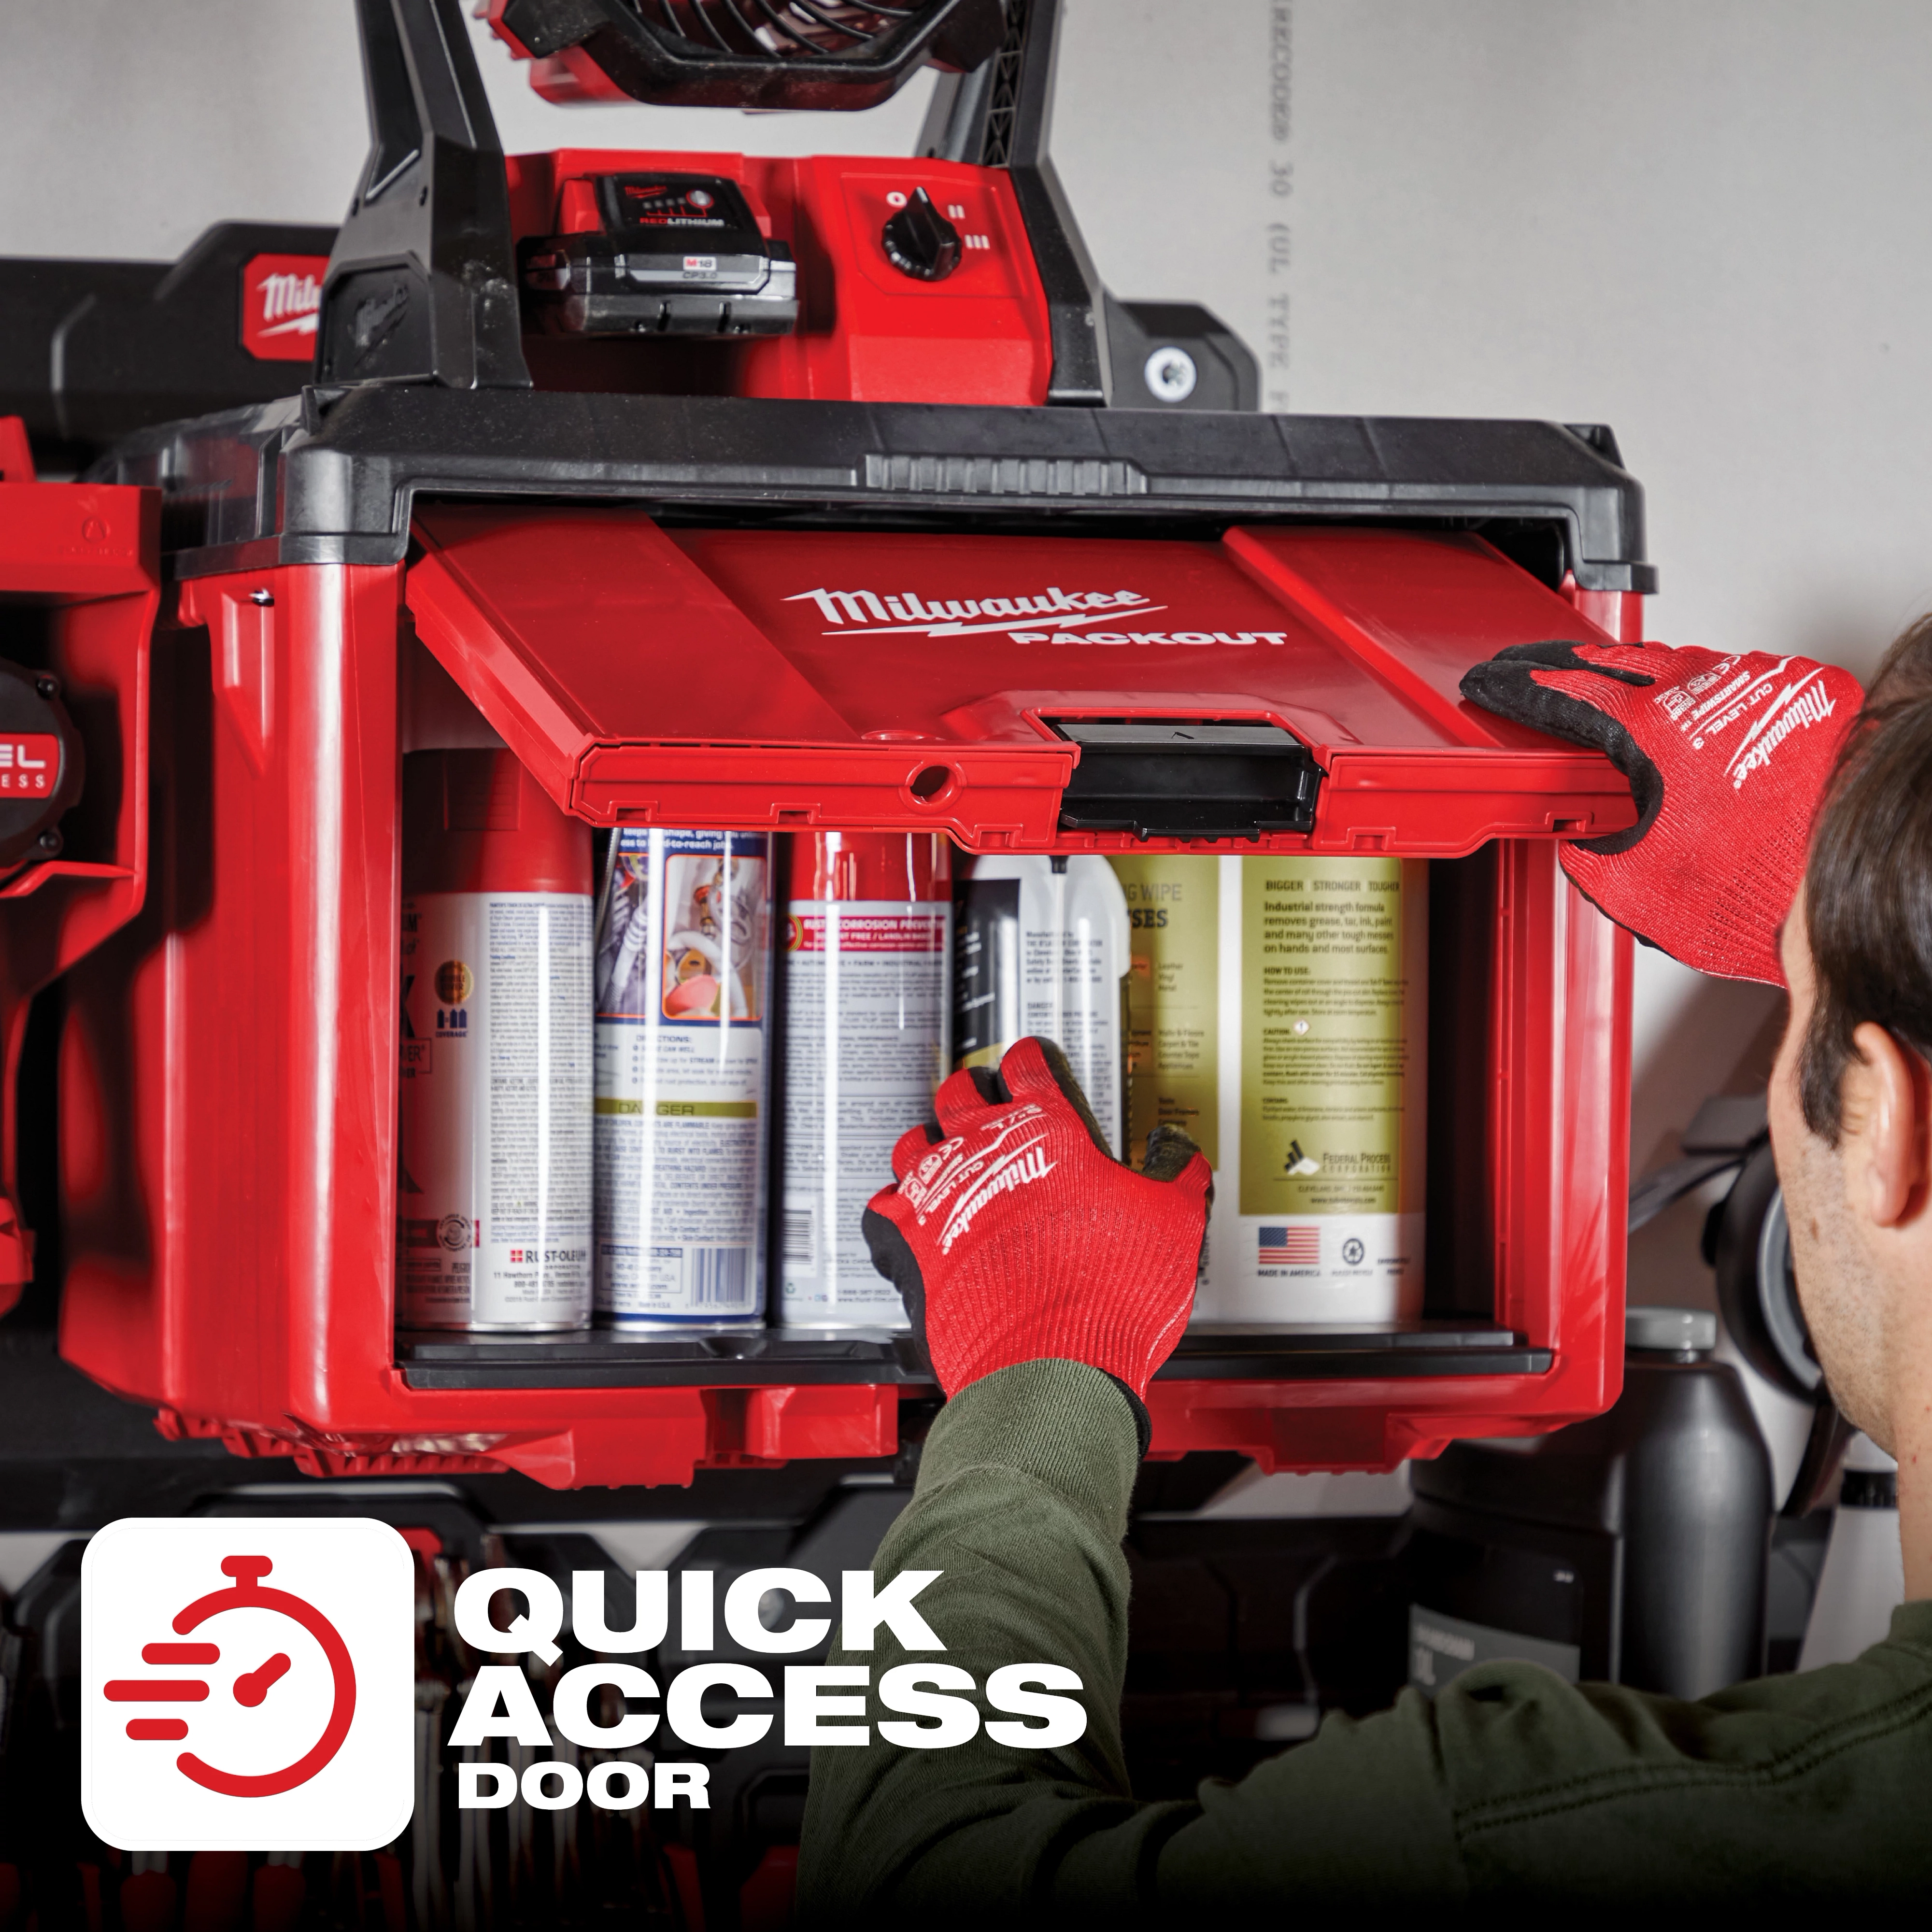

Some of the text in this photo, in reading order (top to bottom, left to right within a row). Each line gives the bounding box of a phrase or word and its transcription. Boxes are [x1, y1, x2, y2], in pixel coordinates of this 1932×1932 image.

[1268, 159, 1293, 196] 30
[639, 217, 724, 226] REDLITHIUM
[780, 587, 1151, 624] Milwaukee
[1008, 631, 1288, 645] PACKOUT
[1691, 670, 1750, 721] SMARTSWIPE
[1749, 683, 1773, 706] CUT
[1705, 702, 1747, 734] LEVEL
[696, 830, 724, 840] giving
[1140, 883, 1183, 902] WIPE
[1265, 880, 1400, 892] BIGGER STRONGER TOUGHER
[1264, 901, 1385, 915] Industrial strength formula
[1264, 917, 1392, 929] removes grease, tar, ink, paint
[1264, 929, 1394, 942] and many other tough messes
[1264, 942, 1389, 954] on hands and most surfaces.
[1159, 962, 1184, 970] Leather
[1264, 966, 1311, 975] HOW TO USE:
[1159, 972, 1175, 982] Vinyl
[618, 1103, 694, 1116] DAGER
[1323, 1152, 1359, 1164] FEDERAL
[958, 1160, 984, 1183] CUT
[925, 1180, 957, 1213] LEVEL
[1257, 1268, 1321, 1278] MADE IN AMERICA
